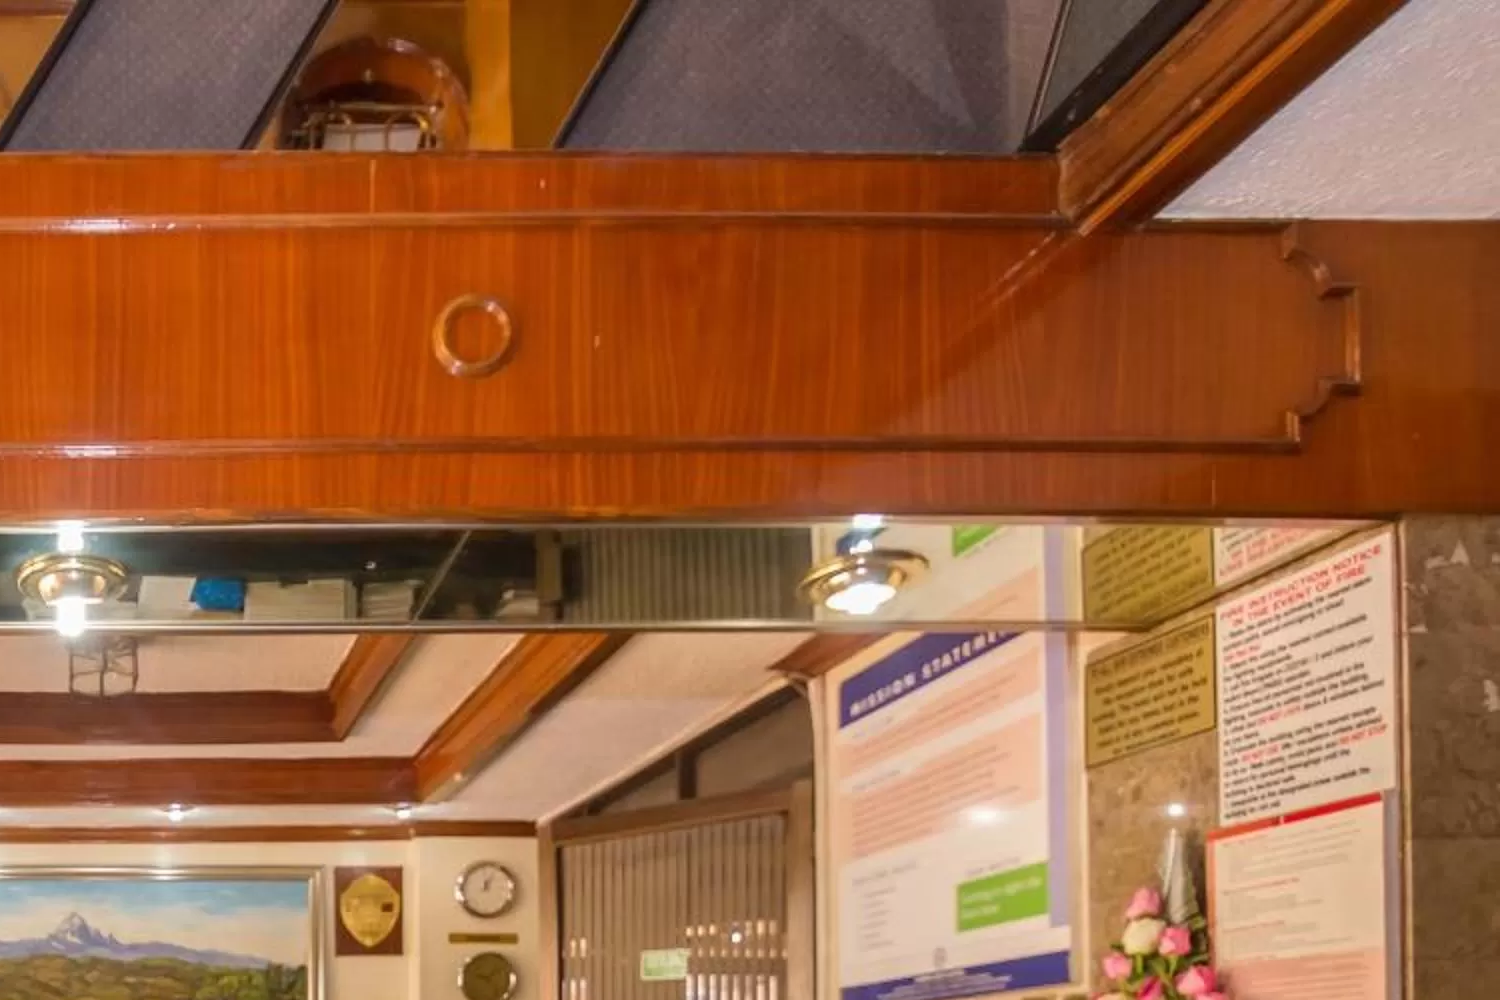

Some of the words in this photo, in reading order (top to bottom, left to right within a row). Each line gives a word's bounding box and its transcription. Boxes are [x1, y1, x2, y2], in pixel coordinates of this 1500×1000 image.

[1250, 570, 1328, 608] INSTRUCTION
[1333, 545, 1381, 570] NOTICE
[1273, 587, 1312, 611] EVENT
[1315, 577, 1332, 592] OF
[1336, 565, 1366, 583] FIRE
[849, 671, 917, 717] MISSION
